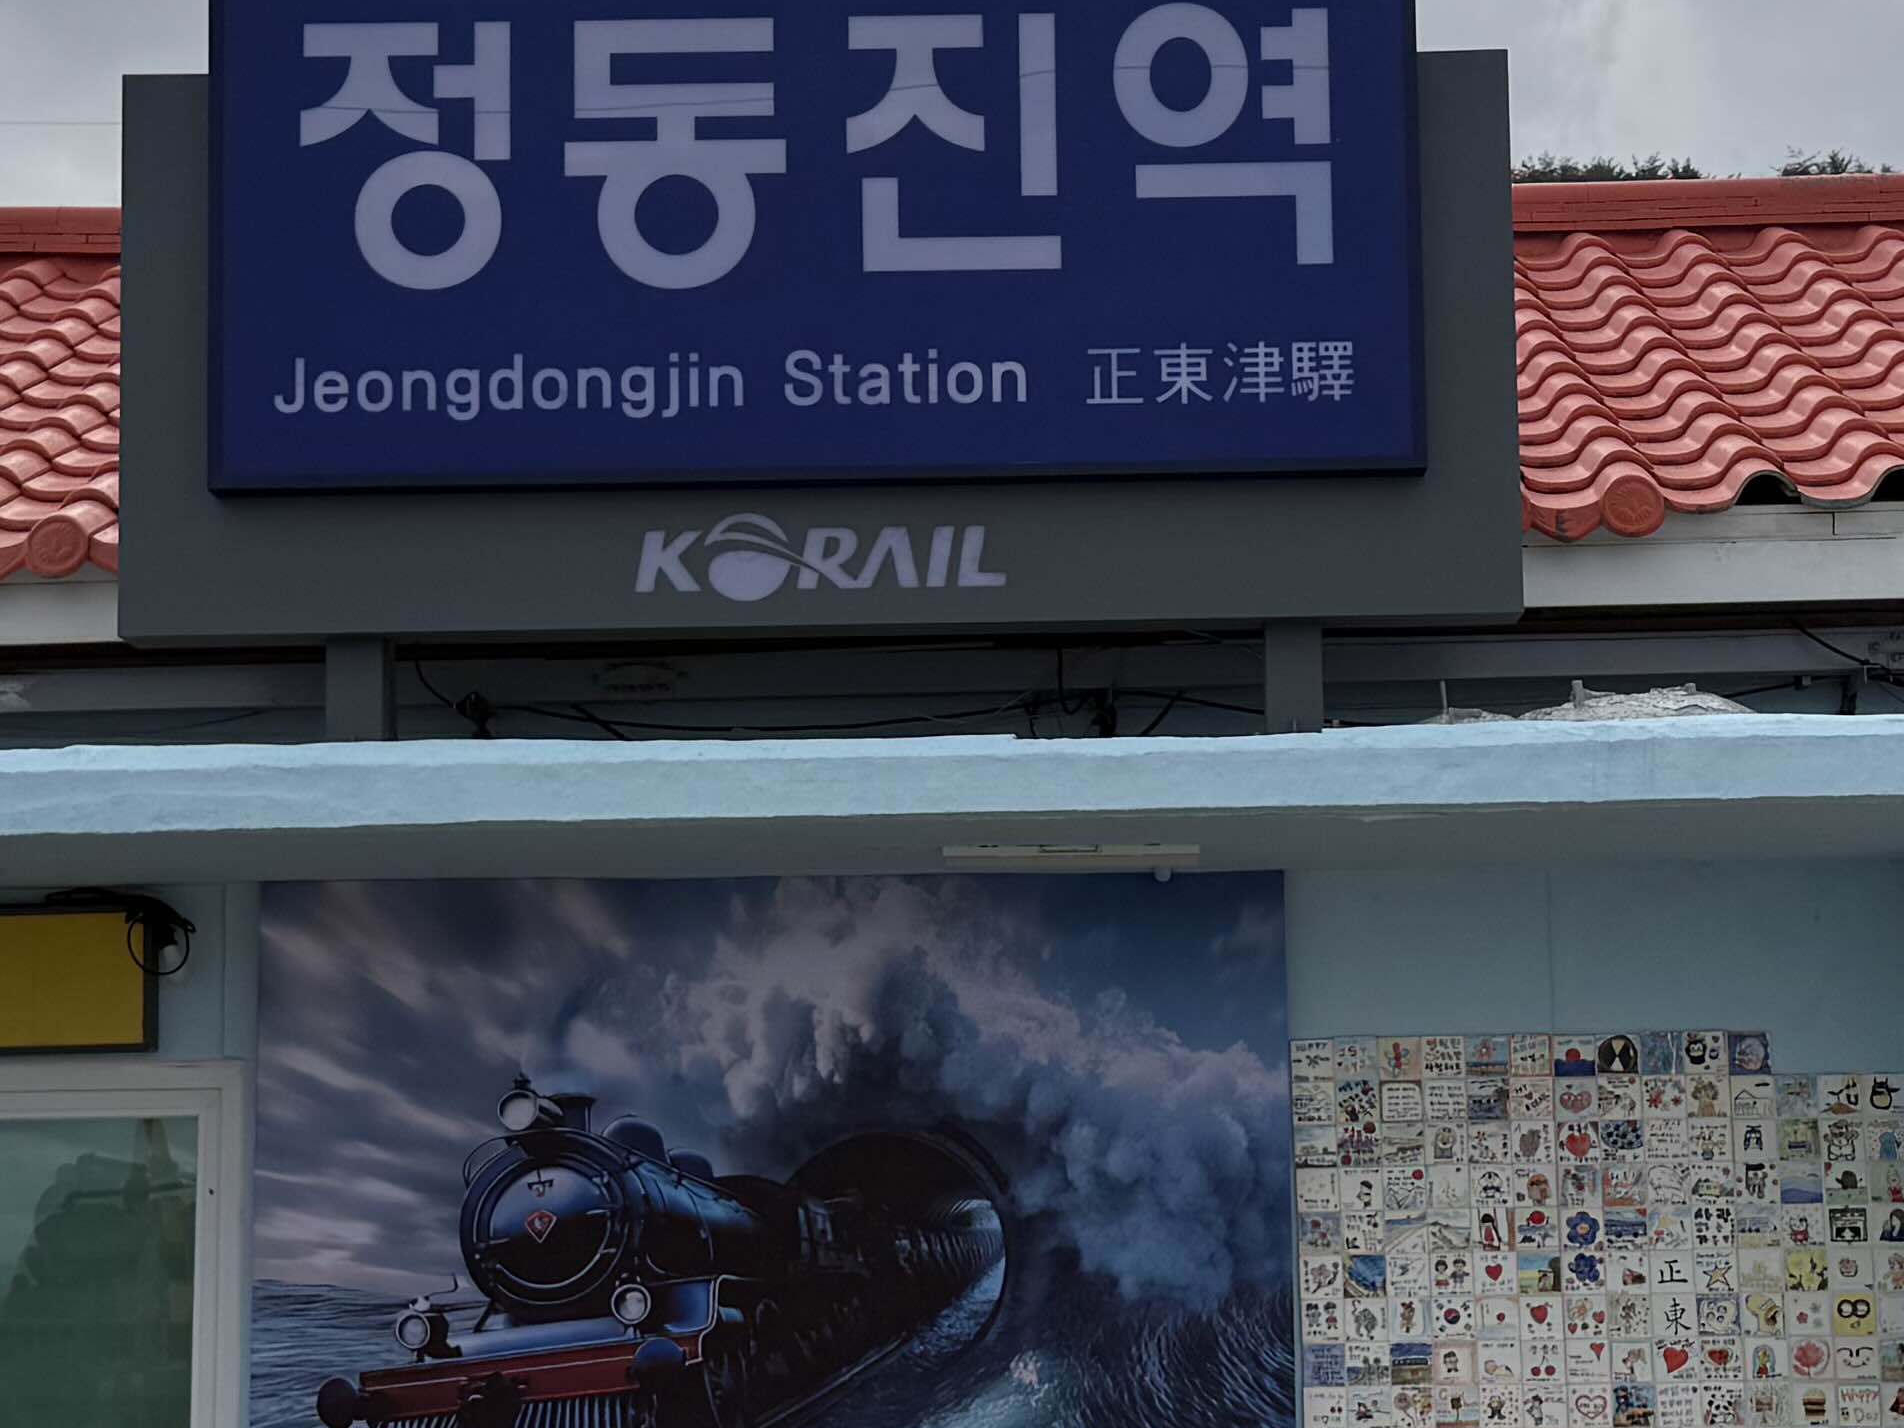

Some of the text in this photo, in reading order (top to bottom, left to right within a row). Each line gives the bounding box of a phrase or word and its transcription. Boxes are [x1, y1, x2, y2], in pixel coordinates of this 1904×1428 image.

[298, 1, 1335, 291] 정동진역
[274, 340, 1356, 421] Jeongdongjin Station 正東津驛
[634, 512, 1008, 602] KORAIL
[1658, 1259, 1689, 1284] 正
[1663, 1297, 1694, 1336] 東
